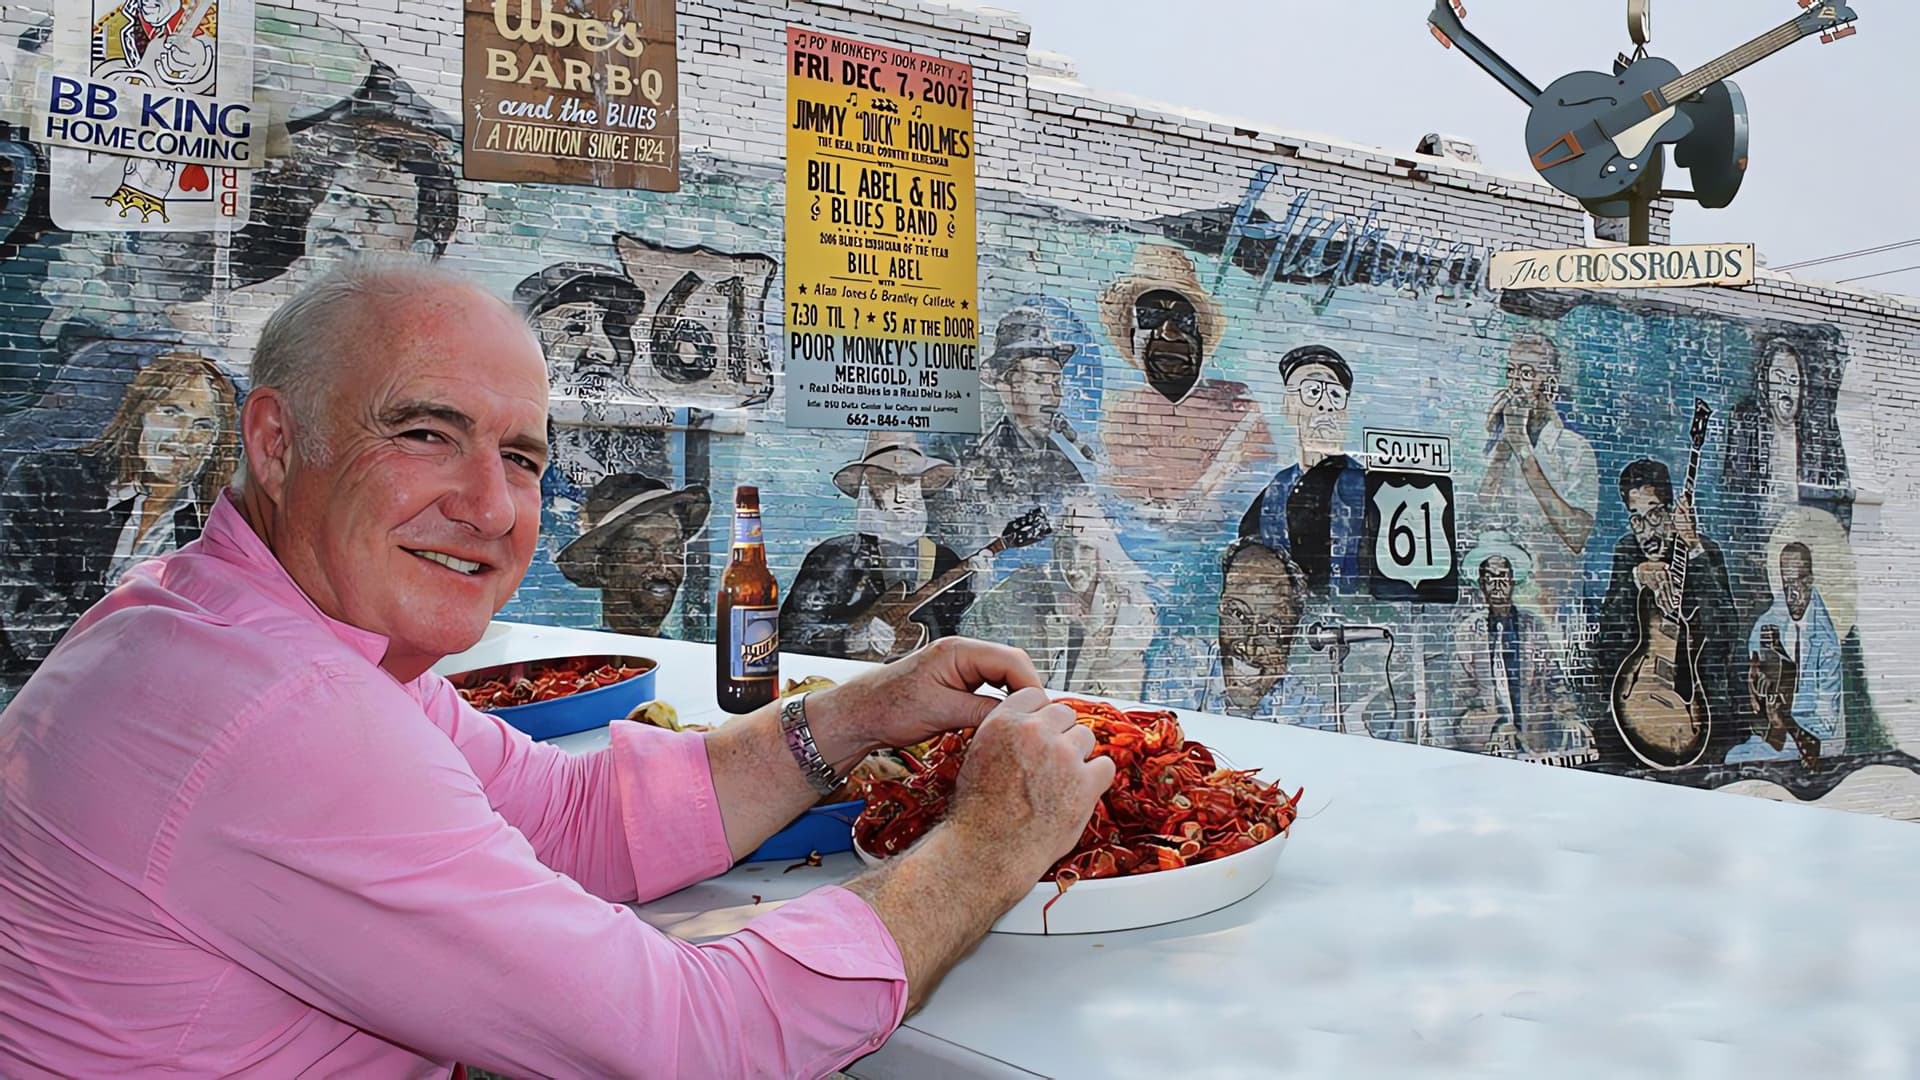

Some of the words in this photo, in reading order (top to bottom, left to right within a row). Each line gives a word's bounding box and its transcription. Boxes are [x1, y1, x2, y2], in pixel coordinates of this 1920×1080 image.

[809, 35, 828, 50] PO'
[831, 39, 888, 64] MONKEY'S
[890, 54, 916, 71] JOOK
[920, 60, 954, 80] PARTY
[794, 51, 834, 83] FRI.
[842, 60, 886, 93] DEC.
[896, 71, 914, 100] 7,
[922, 78, 969, 110] 2007
[50, 76, 118, 120] BB
[141, 93, 250, 139] KING
[498, 96, 554, 120] and
[558, 97, 598, 125] the
[606, 102, 657, 130] BLUES
[46, 116, 249, 161] HOMECOMING
[486, 123, 500, 149] A
[506, 124, 582, 156] TRADITION
[588, 133, 630, 160] SINCE
[633, 137, 666, 163] 1924
[792, 99, 847, 137] JIMMY
[908, 120, 970, 159] HOLMES
[817, 135, 833, 148] THE
[835, 139, 854, 152] REAL
[856, 142, 875, 155] DEAL
[807, 160, 845, 195] BILL
[858, 167, 903, 204] ABEL
[910, 176, 923, 207] &
[930, 179, 957, 211] HIS
[831, 197, 884, 229] BLUES
[895, 206, 938, 236] BAND
[839, 235, 863, 248] BLUES
[865, 238, 902, 253] MUSICIAN
[903, 243, 913, 254] OF
[915, 245, 929, 257] THE
[931, 247, 949, 258] YEAR
[848, 251, 879, 276] BILL
[889, 256, 923, 281] ABEL
[1508, 258, 1551, 287] The
[1556, 249, 1742, 283] CROSSROADS
[814, 283, 838, 297] Alan
[842, 285, 868, 300] Jones
[870, 288, 878, 301] &
[881, 290, 919, 307] Brantley
[652, 271, 744, 384] 61
[791, 303, 818, 326] 7:30
[826, 306, 846, 329] TIL
[853, 307, 861, 330] ?
[902, 318, 917, 335] AT
[920, 319, 941, 337] THE
[944, 316, 975, 340] DOOR
[791, 332, 835, 362] POOR
[843, 335, 918, 367] MONKEY'S
[925, 342, 977, 371] LOUNGE
[809, 383, 830, 393] Real
[831, 383, 855, 395] Delta
[857, 385, 881, 396] Blues
[901, 388, 919, 398] Real
[920, 388, 942, 399] Delta
[835, 366, 912, 387] MERIGOLD,
[919, 370, 939, 387] MS
[1375, 437, 1443, 466] SOUTH
[1388, 500, 1433, 567] 61
